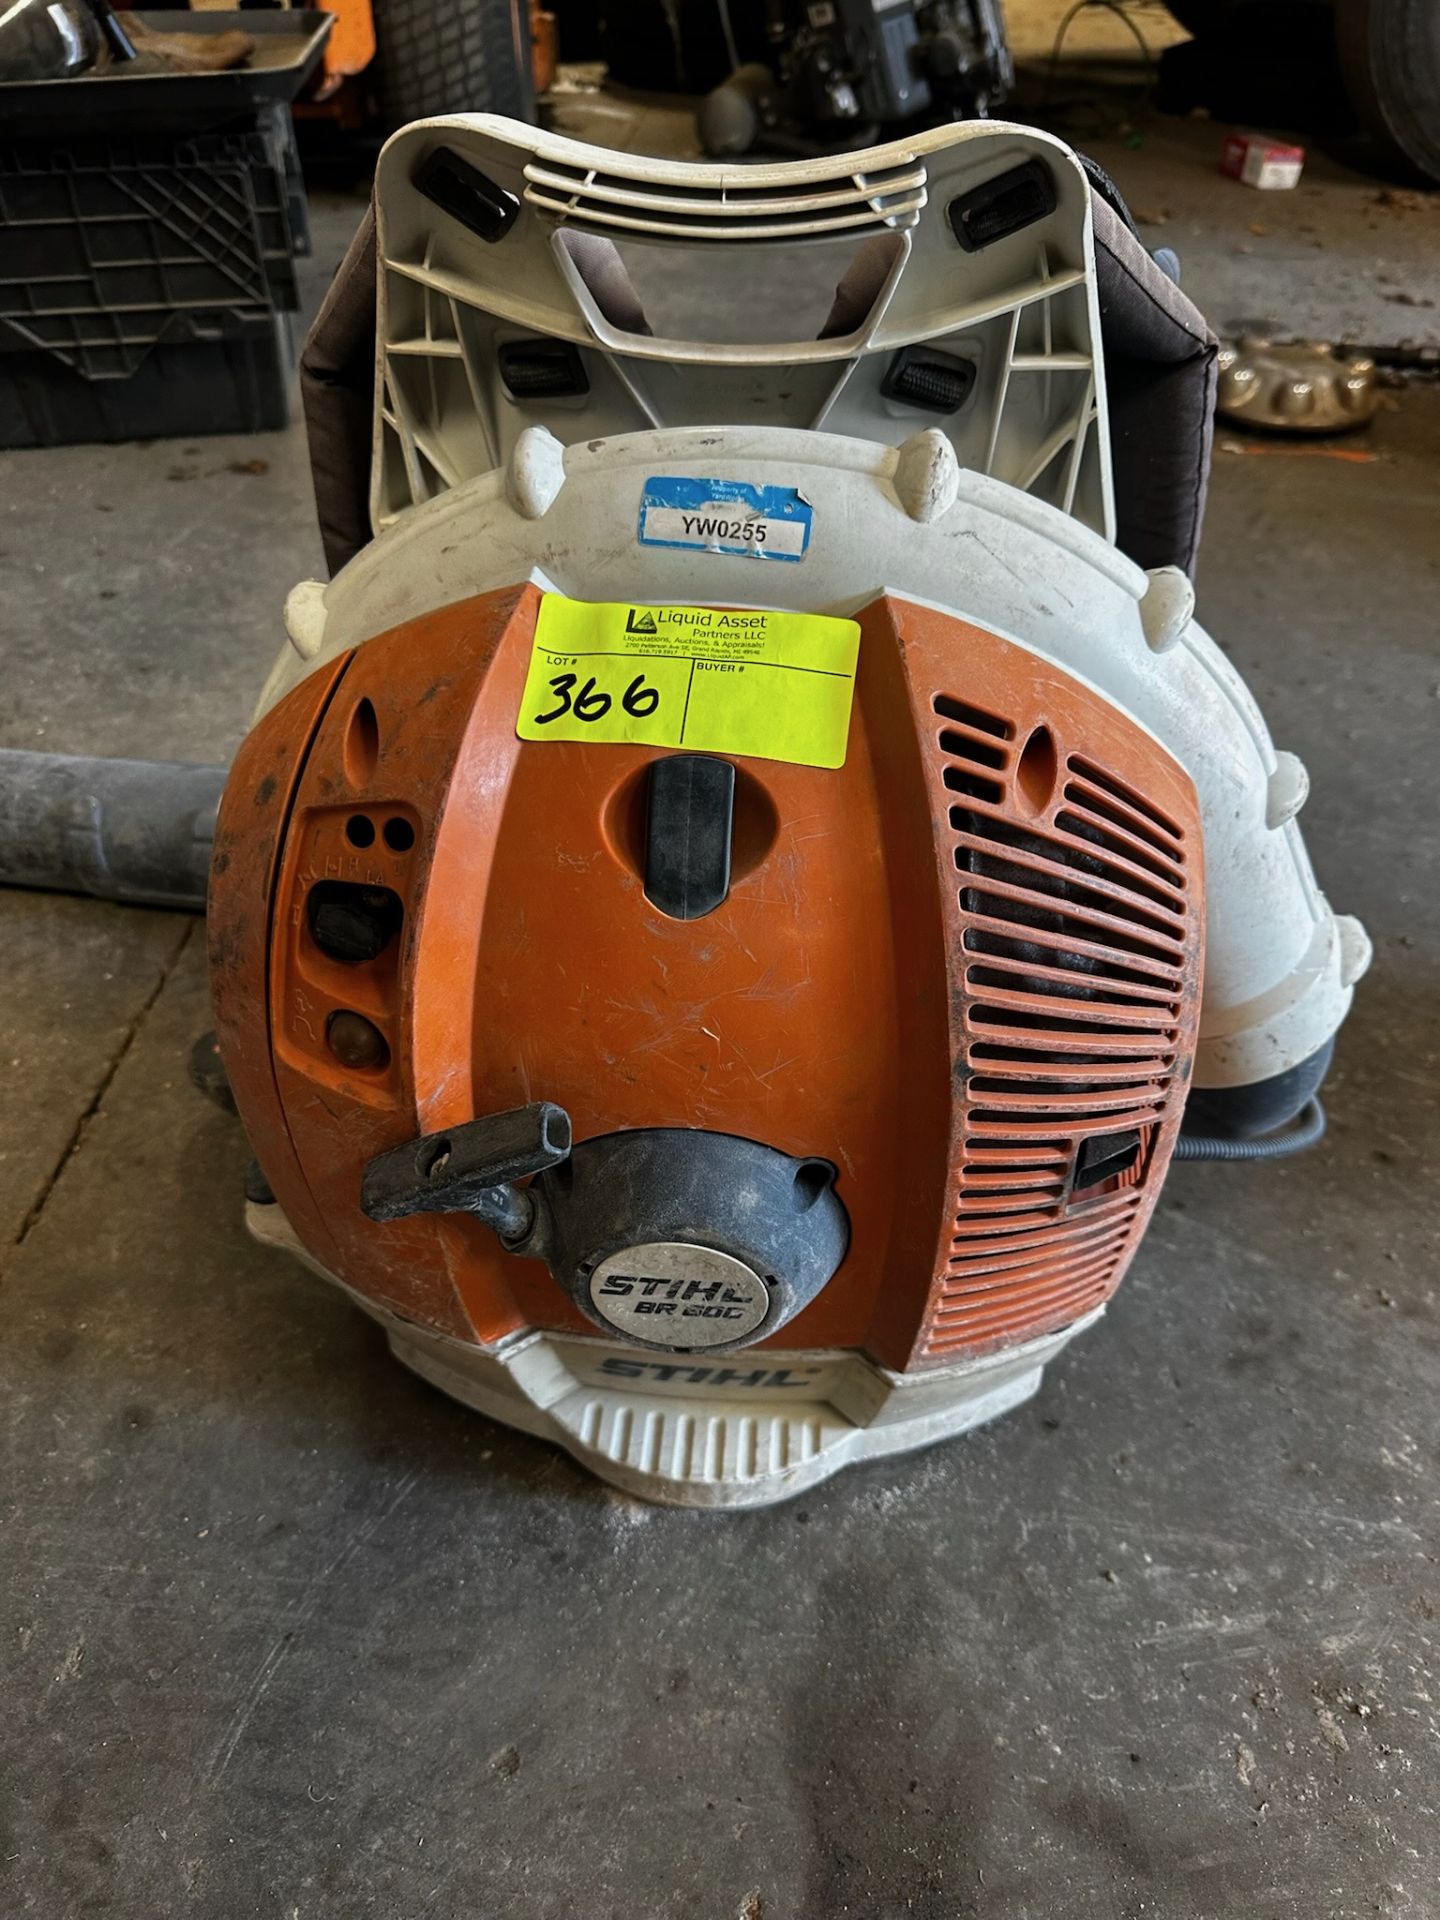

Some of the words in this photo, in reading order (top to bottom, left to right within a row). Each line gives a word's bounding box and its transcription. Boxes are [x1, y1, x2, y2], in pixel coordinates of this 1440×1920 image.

[682, 516, 767, 543] YW0255
[658, 610, 712, 626] Liquid
[717, 615, 768, 629] Asset
[623, 634, 671, 643] Liquidations,
[674, 637, 709, 646] Auctions,
[722, 641, 765, 649] Appraisals!
[692, 628, 740, 640] Partners
[744, 631, 766, 640] LLC
[546, 656, 569, 665] LOT
[696, 662, 735, 672] BUYER
[534, 673, 660, 724] 366
[599, 1274, 753, 1304] STIHL
[634, 1300, 677, 1316] BR
